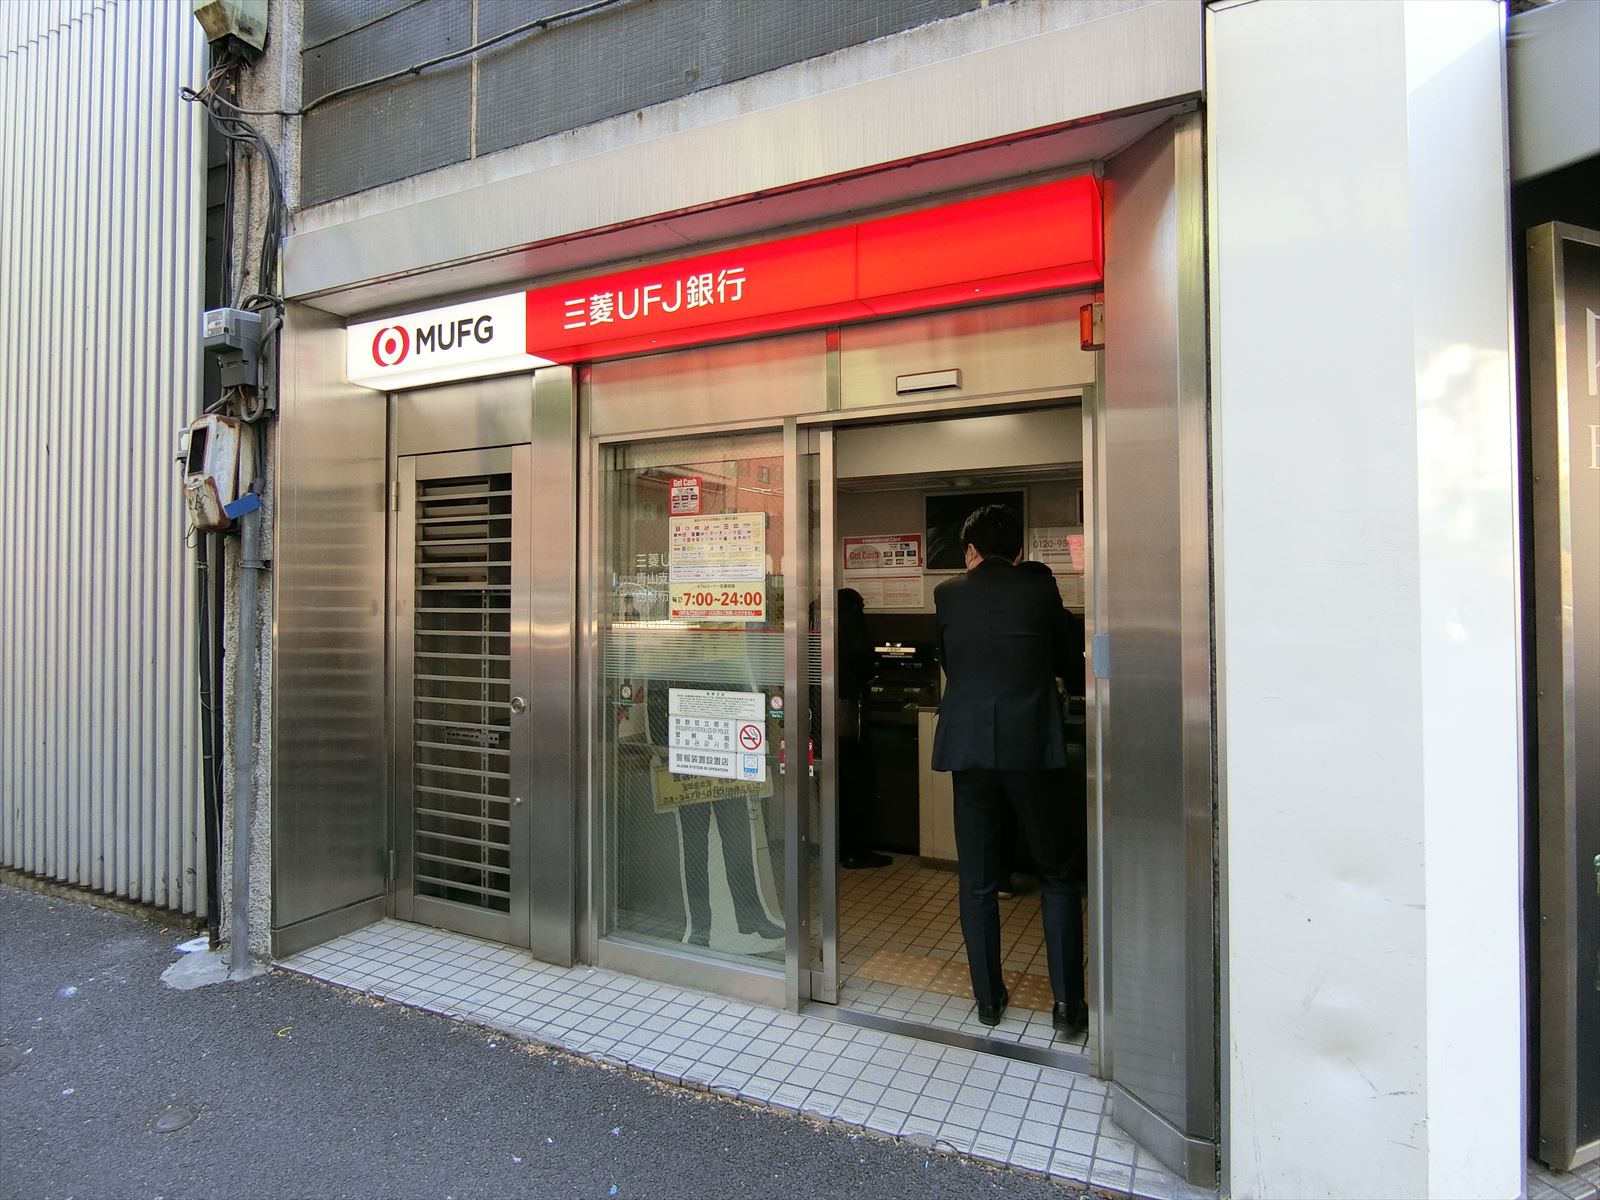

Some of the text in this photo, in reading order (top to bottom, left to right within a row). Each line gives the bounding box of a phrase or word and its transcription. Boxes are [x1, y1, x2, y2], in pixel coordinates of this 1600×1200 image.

[563, 267, 746, 330] 三菱UFJ銀行
[415, 315, 493, 355] MUFG
[676, 753, 729, 766] 警報装置設置店
